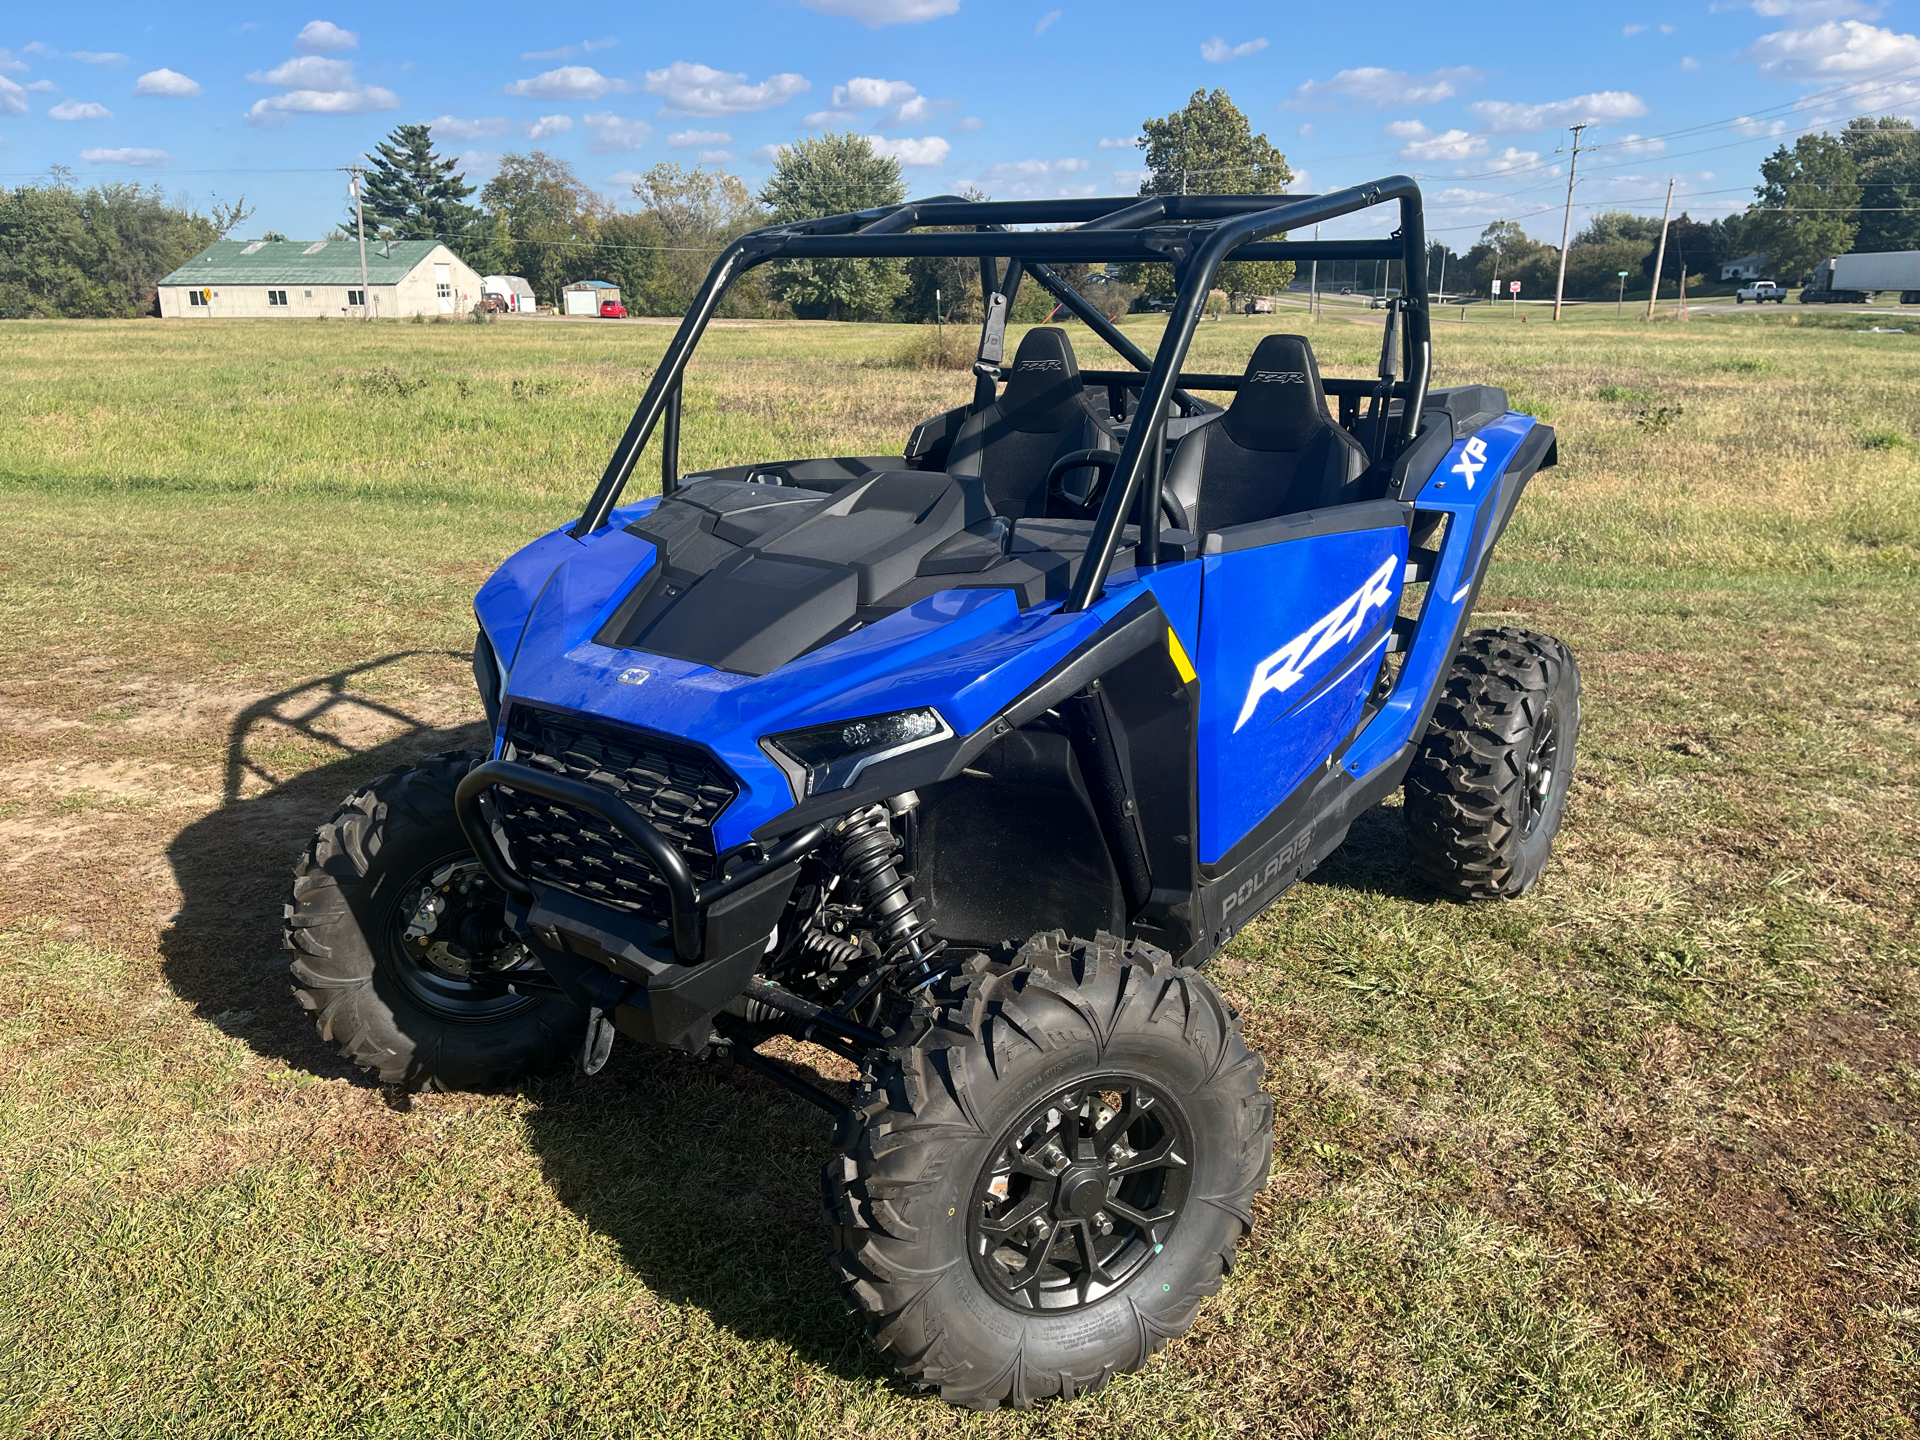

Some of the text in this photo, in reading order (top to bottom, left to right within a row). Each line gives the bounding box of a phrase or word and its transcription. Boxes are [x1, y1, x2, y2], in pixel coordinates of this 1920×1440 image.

[1017, 359, 1062, 372] RZR
[1250, 371, 1305, 385] RZR
[1451, 436, 1488, 491] XP
[1233, 554, 1398, 734] RZR
[1222, 829, 1311, 920] POLARIS
